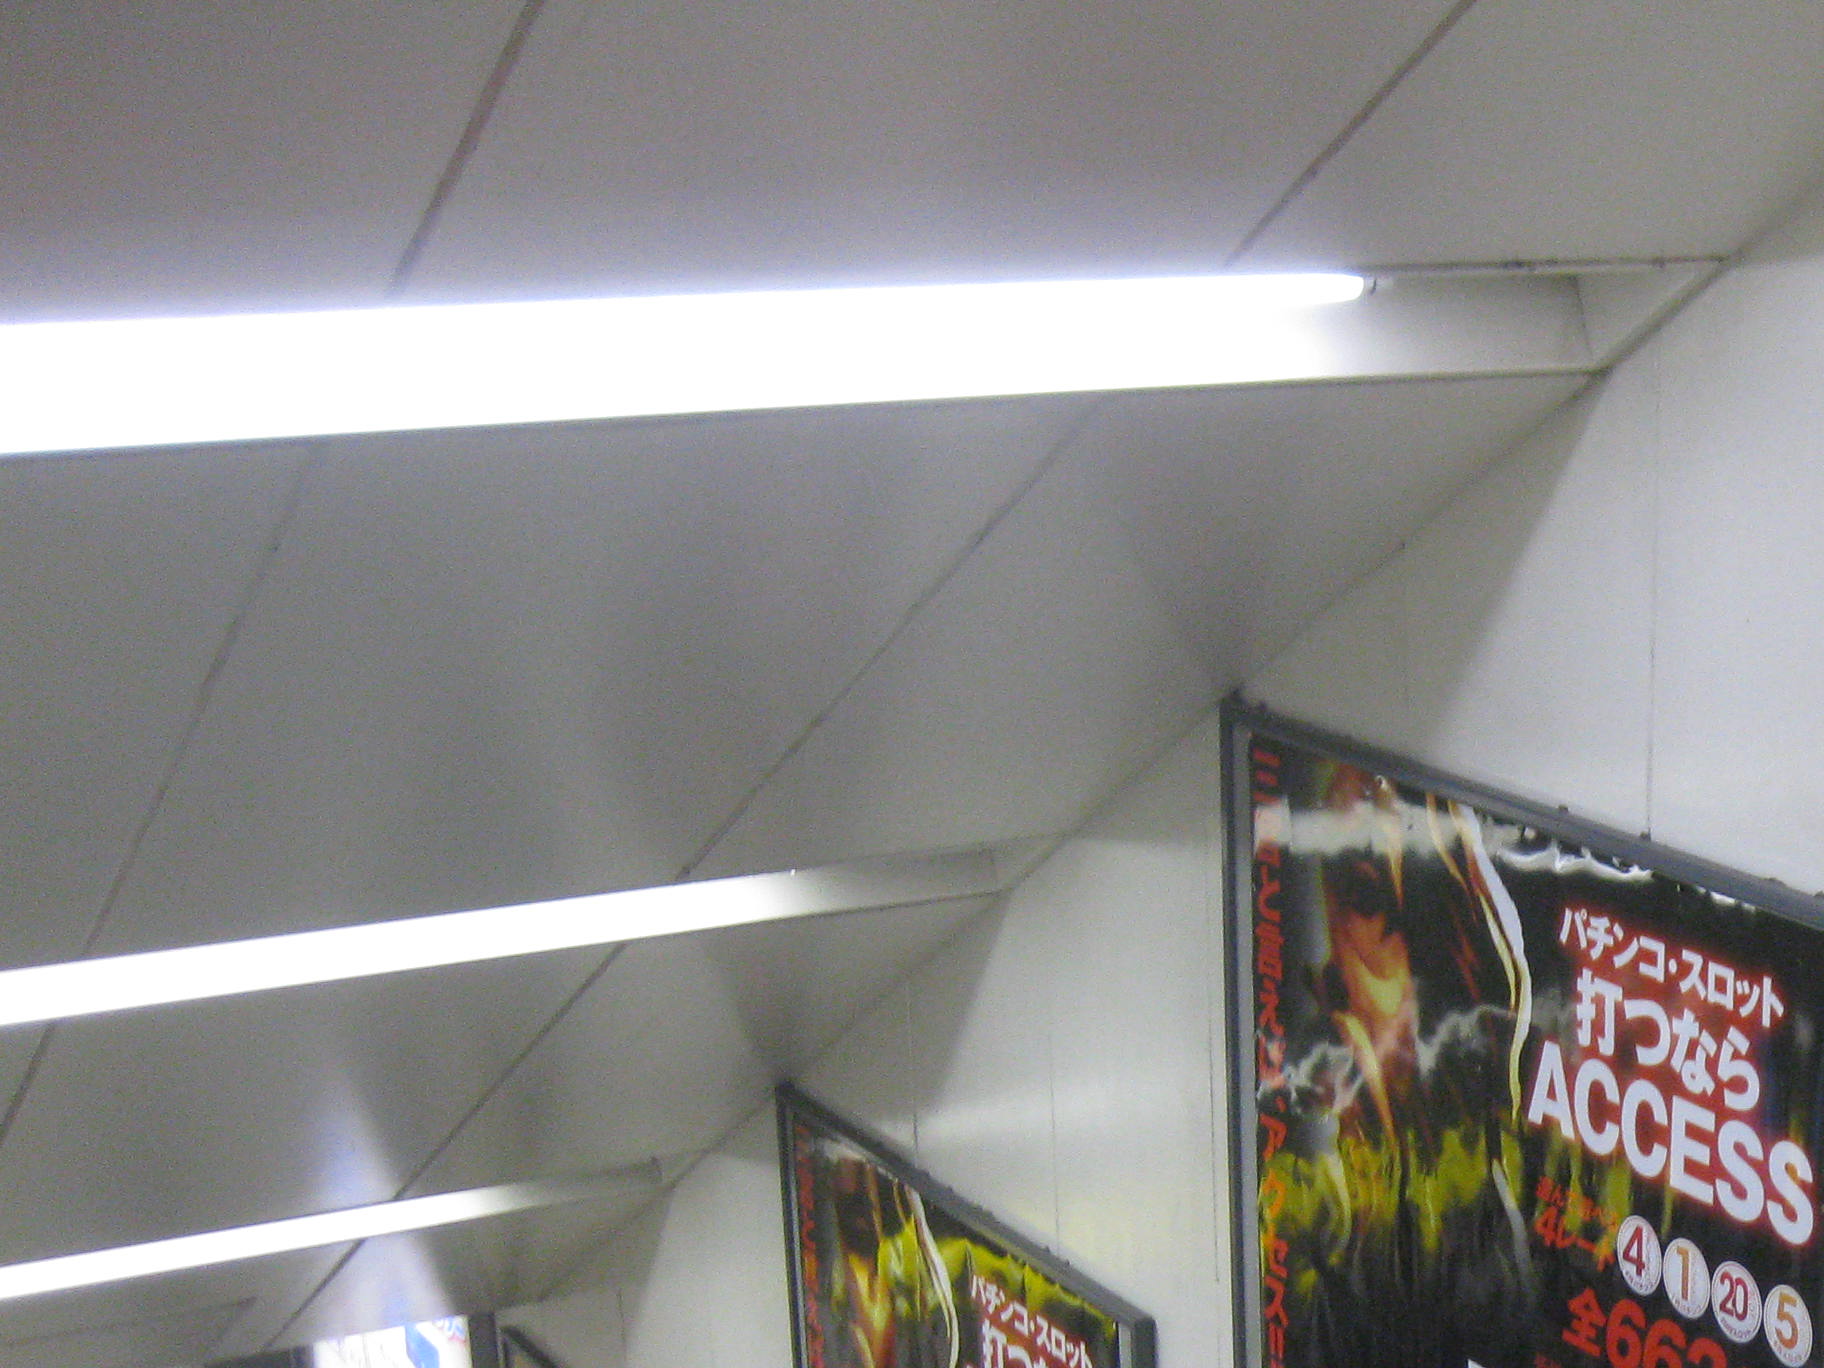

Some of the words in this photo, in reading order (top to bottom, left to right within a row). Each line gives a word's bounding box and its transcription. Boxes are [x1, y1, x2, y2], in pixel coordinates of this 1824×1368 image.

[1559, 907, 1785, 1028] パチンコ・スロット
[1576, 967, 1761, 1112] 打つなら
[1528, 1040, 1815, 1245] ACCESS
[1622, 1225, 1646, 1278] 4
[1675, 1245, 1691, 1302] 1
[1719, 1270, 1749, 1321] 20
[1775, 1291, 1799, 1350] 5
